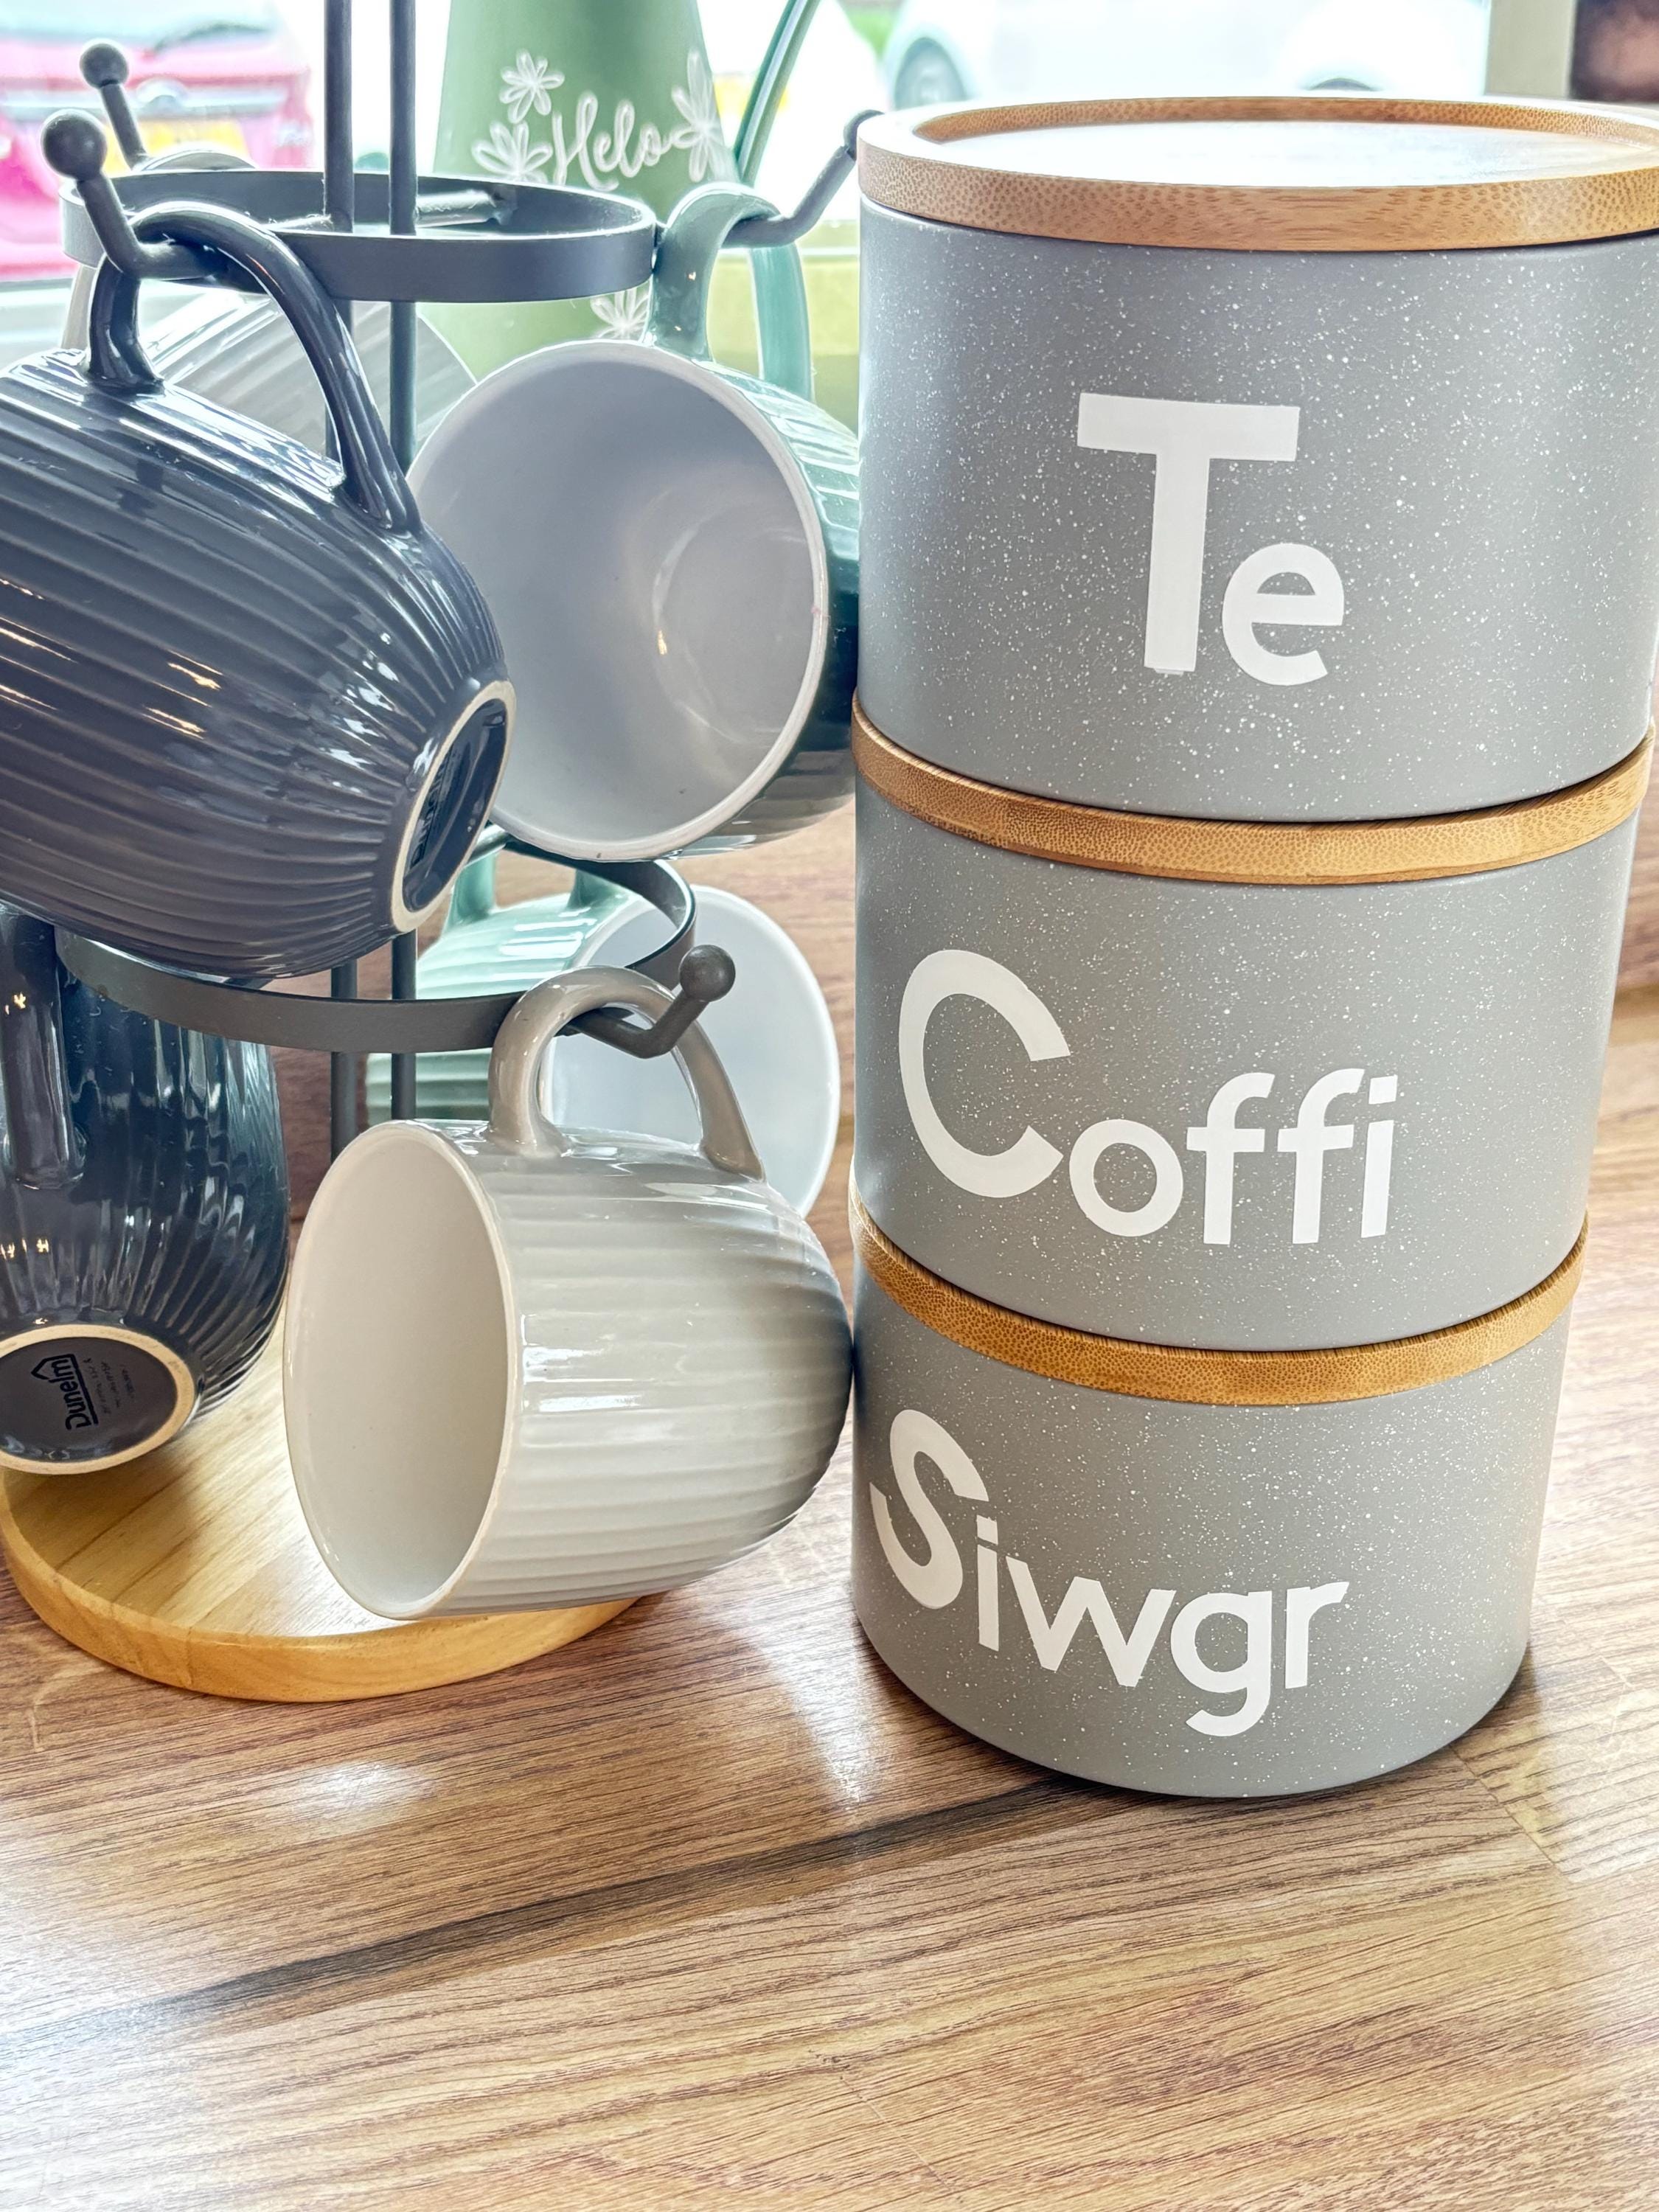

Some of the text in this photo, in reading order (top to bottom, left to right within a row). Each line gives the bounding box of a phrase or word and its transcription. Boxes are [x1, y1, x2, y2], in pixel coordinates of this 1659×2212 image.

[552, 90, 672, 192] Helo
[1077, 392, 1345, 686] Te
[898, 949, 1398, 1245] Coffi
[48, 1357, 92, 1430] Dunelm
[869, 1409, 1349, 1736] Siwgr
